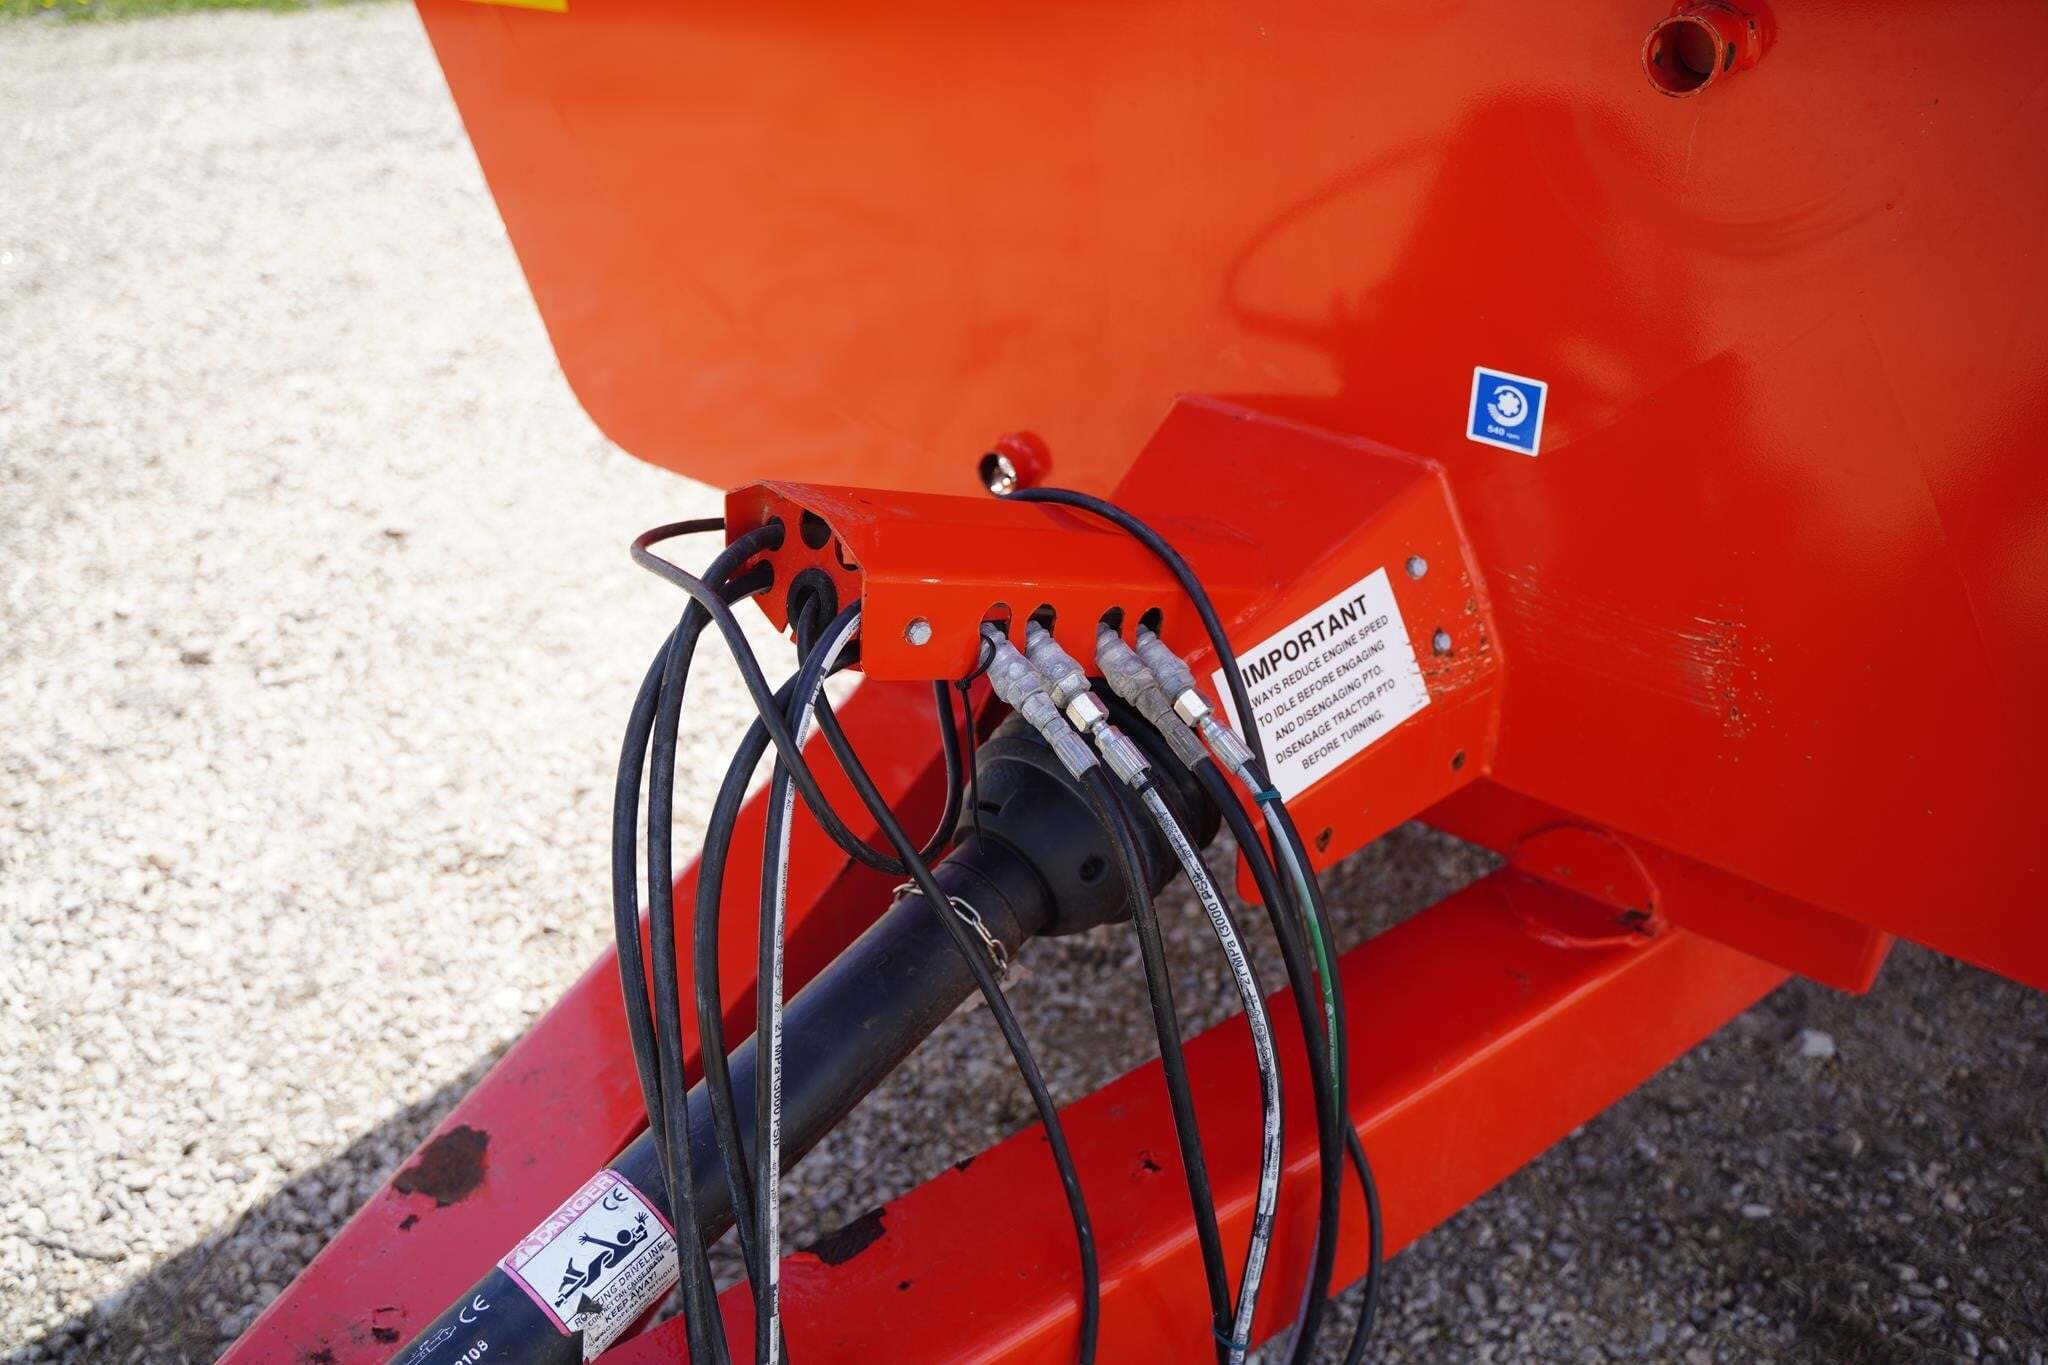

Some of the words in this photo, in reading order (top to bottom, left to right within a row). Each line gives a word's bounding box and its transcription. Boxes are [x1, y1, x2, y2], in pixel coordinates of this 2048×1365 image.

[1242, 594, 1368, 688] IMPORTANT
[1250, 683, 1281, 710] WAYS
[1282, 659, 1321, 689] REDUCE
[1324, 639, 1358, 665] ENGINE
[1359, 615, 1388, 641] SPEED
[1258, 713, 1273, 727] TO
[1273, 697, 1297, 718] IDLE
[1297, 675, 1335, 702] BEFORE
[1336, 640, 1385, 678] ENGAGING
[1275, 721, 1296, 742] AND
[1297, 680, 1361, 726] DISENGAGING
[1363, 664, 1384, 685] PTO.
[1276, 723, 1331, 764] DISENGAGE
[1332, 692, 1375, 727] TRACTOR
[1375, 678, 1395, 699] PTO
[1302, 741, 1340, 769] BEFORE
[1341, 710, 1384, 742] TURNING.
[1206, 900, 1232, 939] (3000
[1224, 939, 1245, 968] MPa
[772, 1044, 782, 1075] MPa
[774, 1022, 782, 1039] 21
[537, 1175, 615, 1247] DANGER
[574, 1284, 619, 1328] ROTING
[619, 1242, 665, 1287] DRIVELINE
[604, 1299, 631, 1324] KEEP
[629, 1270, 658, 1300] AWAY!
[614, 1289, 628, 1303] CAN
[626, 1272, 647, 1291] CAUSE
[645, 1254, 665, 1274] DEATH
